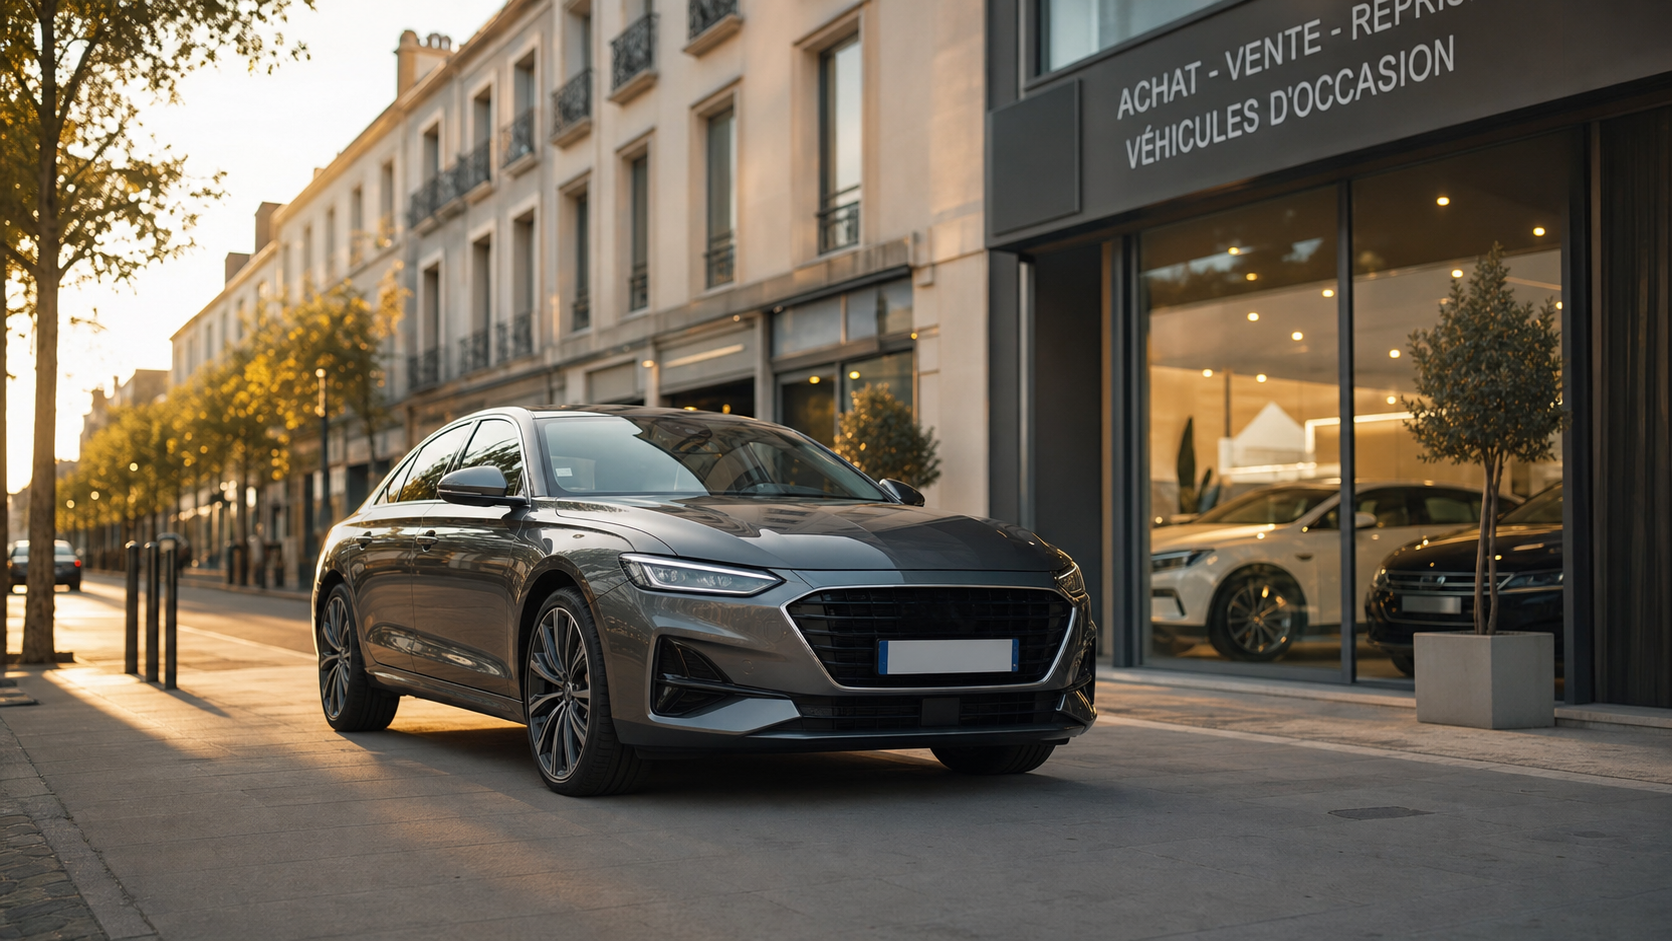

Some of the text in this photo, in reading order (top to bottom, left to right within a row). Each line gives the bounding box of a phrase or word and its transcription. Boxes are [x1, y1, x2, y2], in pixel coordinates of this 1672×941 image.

[1116, 60, 1202, 121] ACHAT
[1208, 69, 1219, 79] -
[1224, 18, 1322, 81] VENTE
[1331, 27, 1342, 36] -
[1125, 34, 1455, 170] VÉHICULES D'OCCASION
